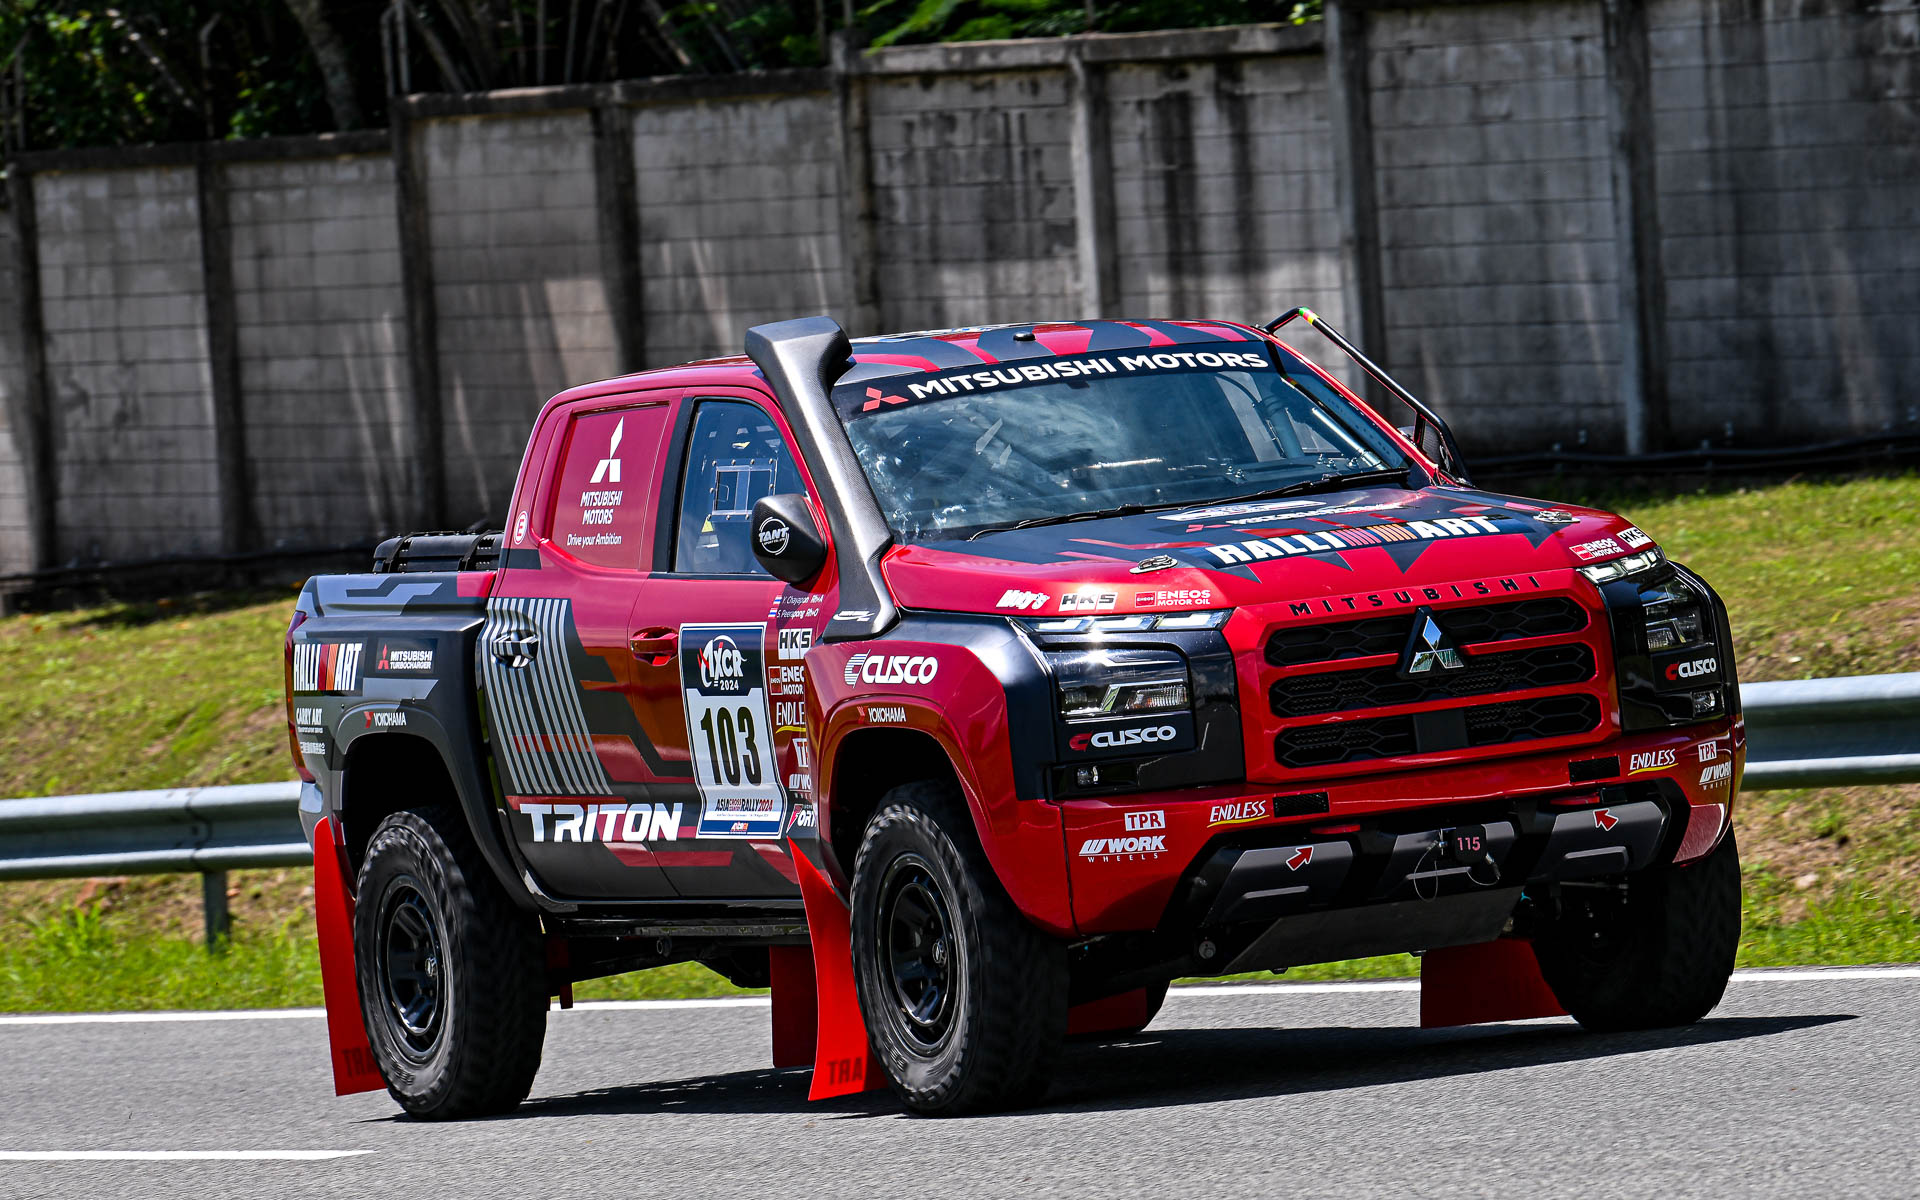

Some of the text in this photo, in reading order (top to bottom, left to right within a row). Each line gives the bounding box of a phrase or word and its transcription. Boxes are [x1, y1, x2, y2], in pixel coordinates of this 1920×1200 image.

[907, 353, 1269, 399] MITSUBISHI MOTORS
[580, 490, 623, 507] MITSUBISHI
[582, 508, 614, 525] MOTORS
[566, 532, 622, 549] Drive your Ambition
[758, 526, 790, 543] TANT
[1619, 528, 1645, 543] HKS
[1582, 537, 1618, 552] ENEOS
[1157, 589, 1211, 600] ENEOS
[1158, 598, 1211, 607] MOTOR OIL
[1288, 575, 1542, 617] MITSUBISHI
[779, 631, 811, 649] HKS
[390, 651, 433, 662] MITSUBISHI
[389, 661, 432, 670] TURBOCHARGER
[862, 655, 938, 686] CUSCO
[1677, 657, 1717, 678] CUSCO
[720, 679, 739, 691] 2024
[783, 684, 804, 695] MOTOR
[374, 711, 407, 727] YOKOHAMA
[868, 706, 906, 724] YOKOHAMA
[1091, 725, 1177, 748] CUSCO
[700, 706, 762, 787] 103
[1700, 743, 1716, 760] TPR
[1630, 748, 1676, 770] ENDLESS
[714, 798, 729, 812] ASIA
[740, 798, 760, 812] RALLY
[758, 799, 774, 812] 2024
[1209, 800, 1267, 822] ENDLESS
[519, 802, 683, 843] TRITON
[1128, 812, 1162, 828] TPR
[1107, 835, 1166, 854] WORK
[1457, 836, 1481, 851] 115
[1087, 853, 1159, 863] WHEELS
